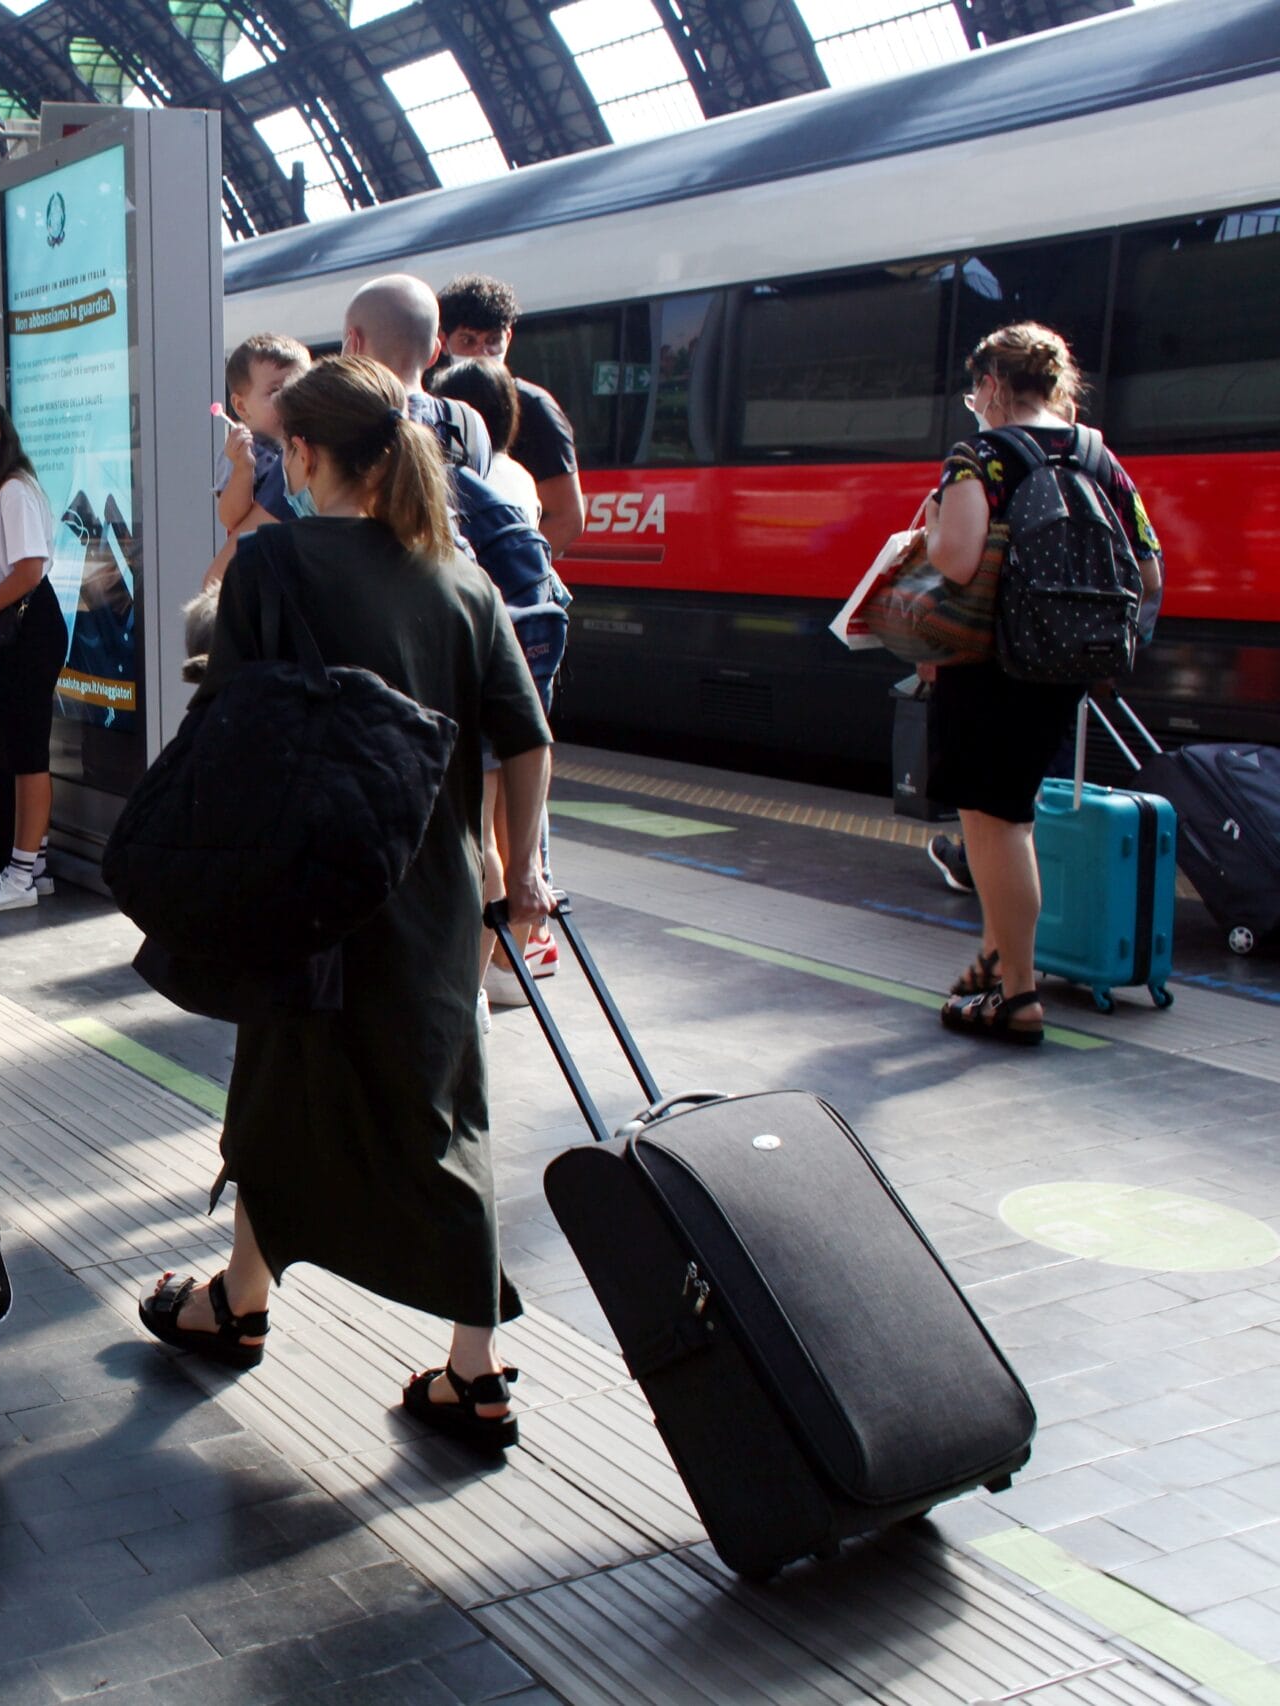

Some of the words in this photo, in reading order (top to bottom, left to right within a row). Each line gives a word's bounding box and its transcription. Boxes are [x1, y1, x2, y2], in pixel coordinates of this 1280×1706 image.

[15, 316, 29, 332] Non
[29, 307, 70, 329] abbassiamo
[70, 303, 78, 319] la
[79, 295, 111, 322] guardia!
[584, 492, 665, 534] SSA
